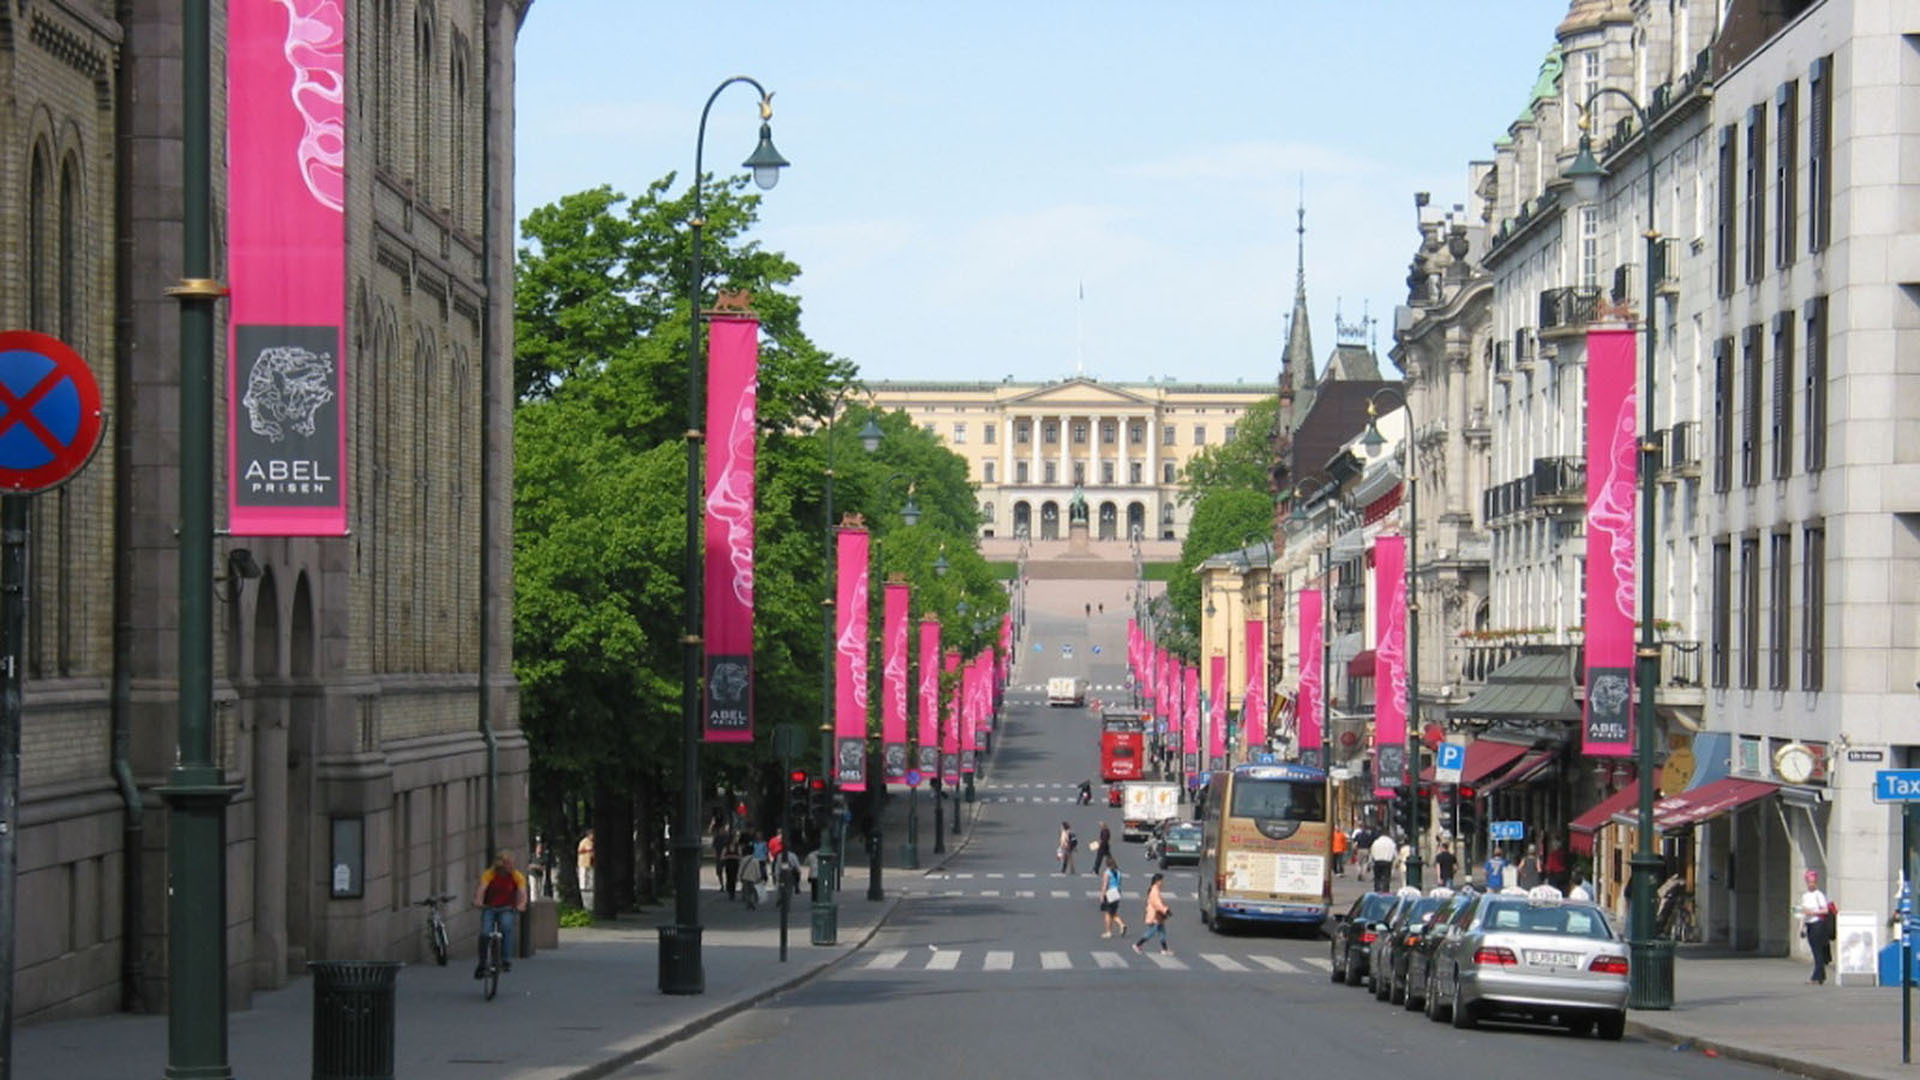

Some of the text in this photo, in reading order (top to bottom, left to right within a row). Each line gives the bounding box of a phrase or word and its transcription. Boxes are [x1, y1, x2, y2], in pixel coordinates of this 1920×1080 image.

[244, 460, 331, 480] ABEL
[252, 483, 324, 493] PRISEN
[710, 710, 747, 720] ABEL
[1590, 723, 1626, 732] ABEL
[1443, 747, 1457, 766] P
